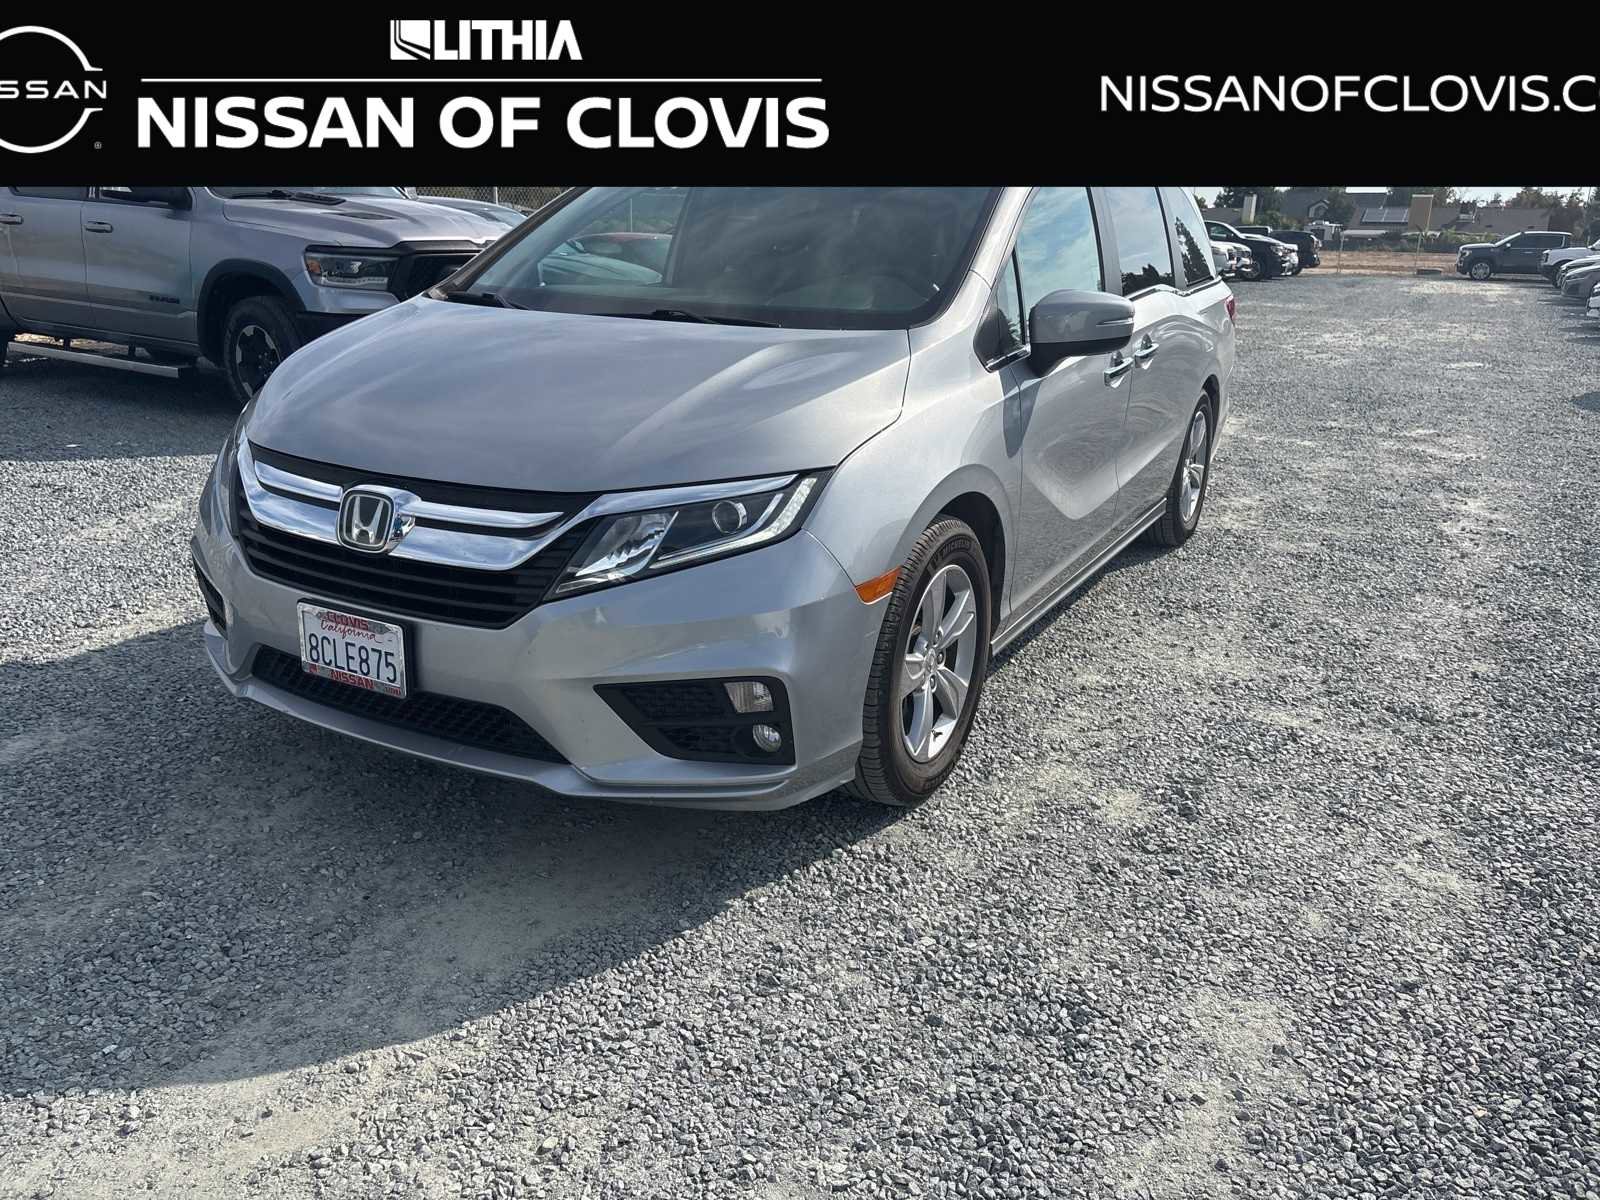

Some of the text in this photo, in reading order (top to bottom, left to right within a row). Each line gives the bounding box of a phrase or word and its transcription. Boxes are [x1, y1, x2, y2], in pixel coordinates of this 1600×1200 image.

[320, 620, 383, 643] California
[326, 611, 369, 631] CLOVIS
[308, 633, 397, 683] 8CLE875
[330, 669, 374, 689] NISSAN
